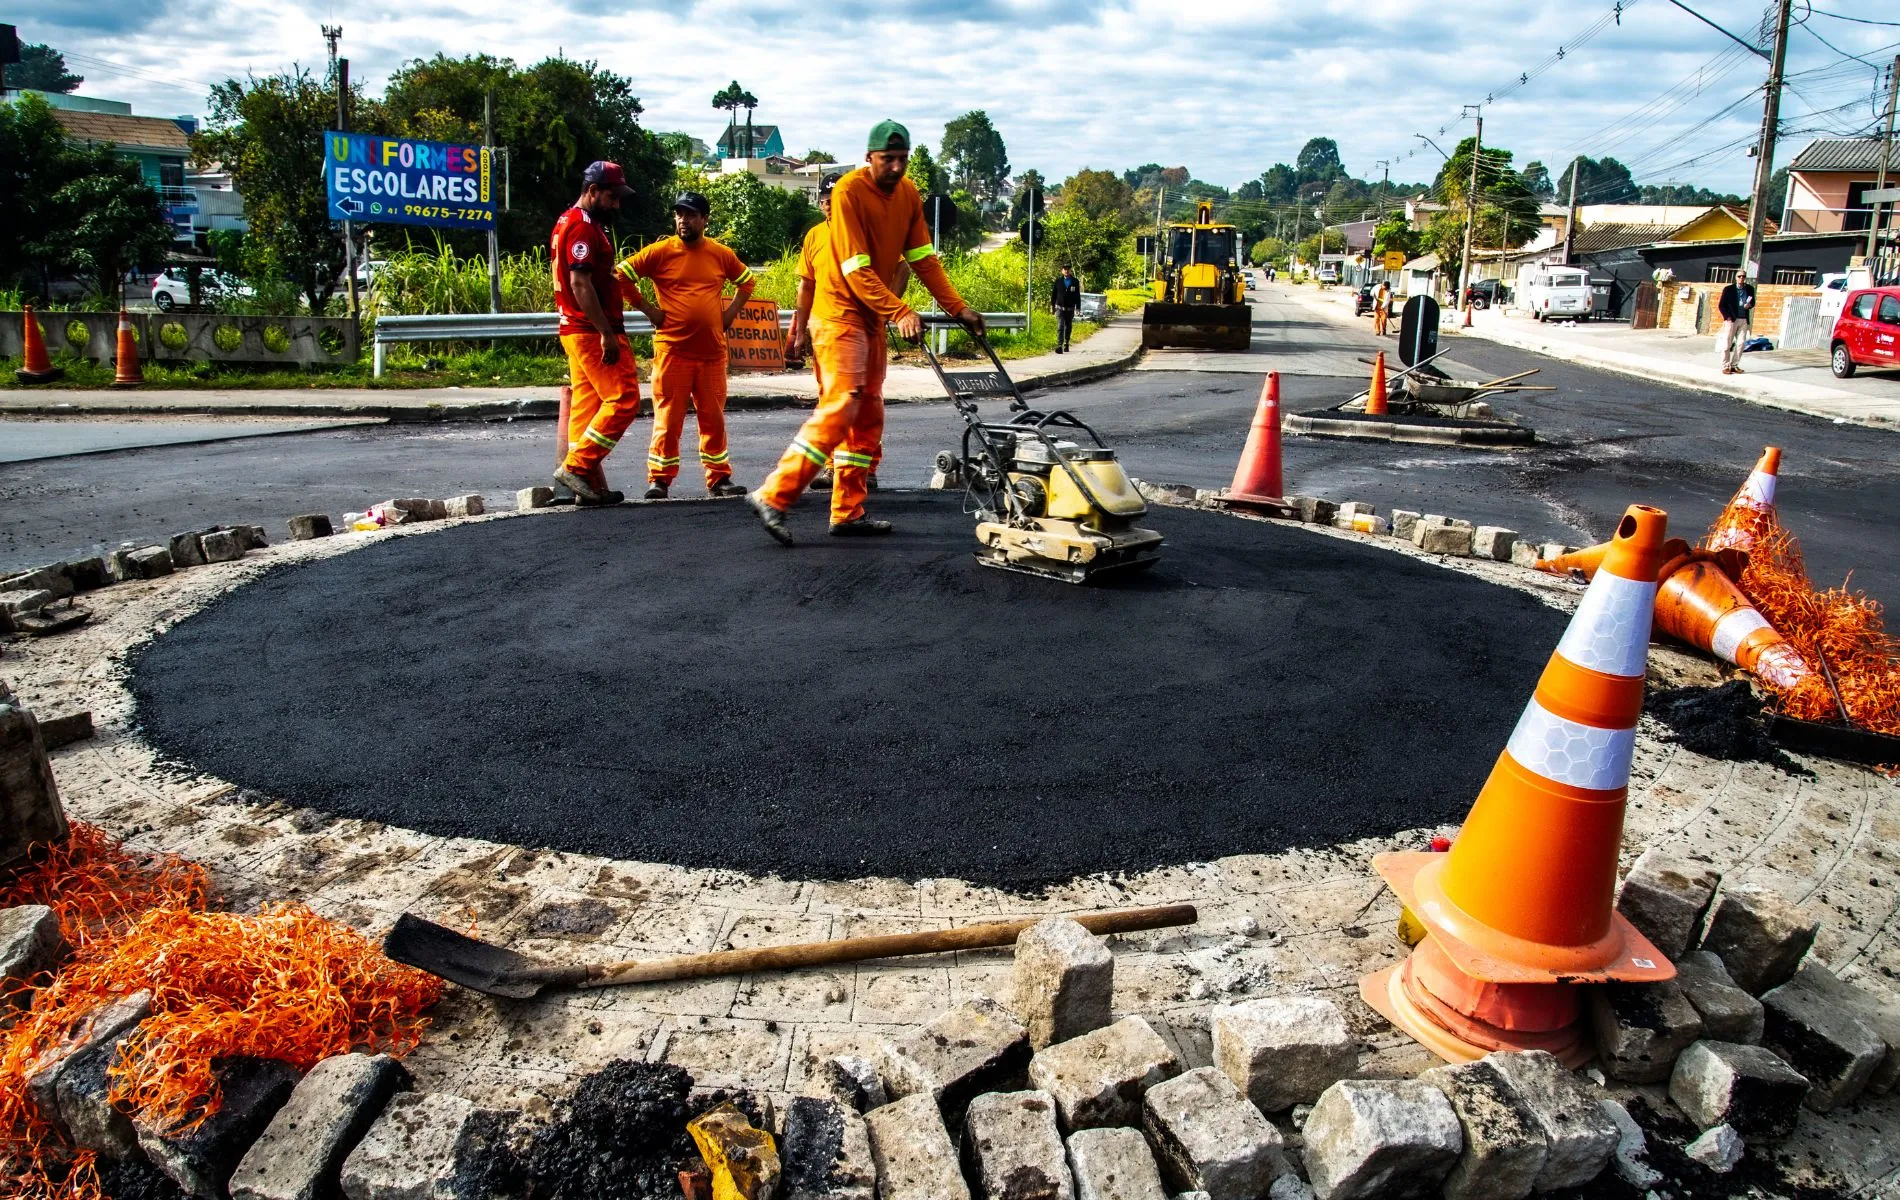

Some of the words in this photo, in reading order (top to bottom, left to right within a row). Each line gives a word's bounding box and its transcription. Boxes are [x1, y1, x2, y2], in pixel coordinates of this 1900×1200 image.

[333, 136, 478, 173] UNIFORMES
[335, 167, 478, 203] ESCOLARES
[404, 204, 493, 221] 99675-7274
[738, 306, 775, 324] ENÇÃO
[728, 327, 778, 341] DEGRAU
[730, 347, 746, 360] NA
[748, 348, 780, 360] PISTA
